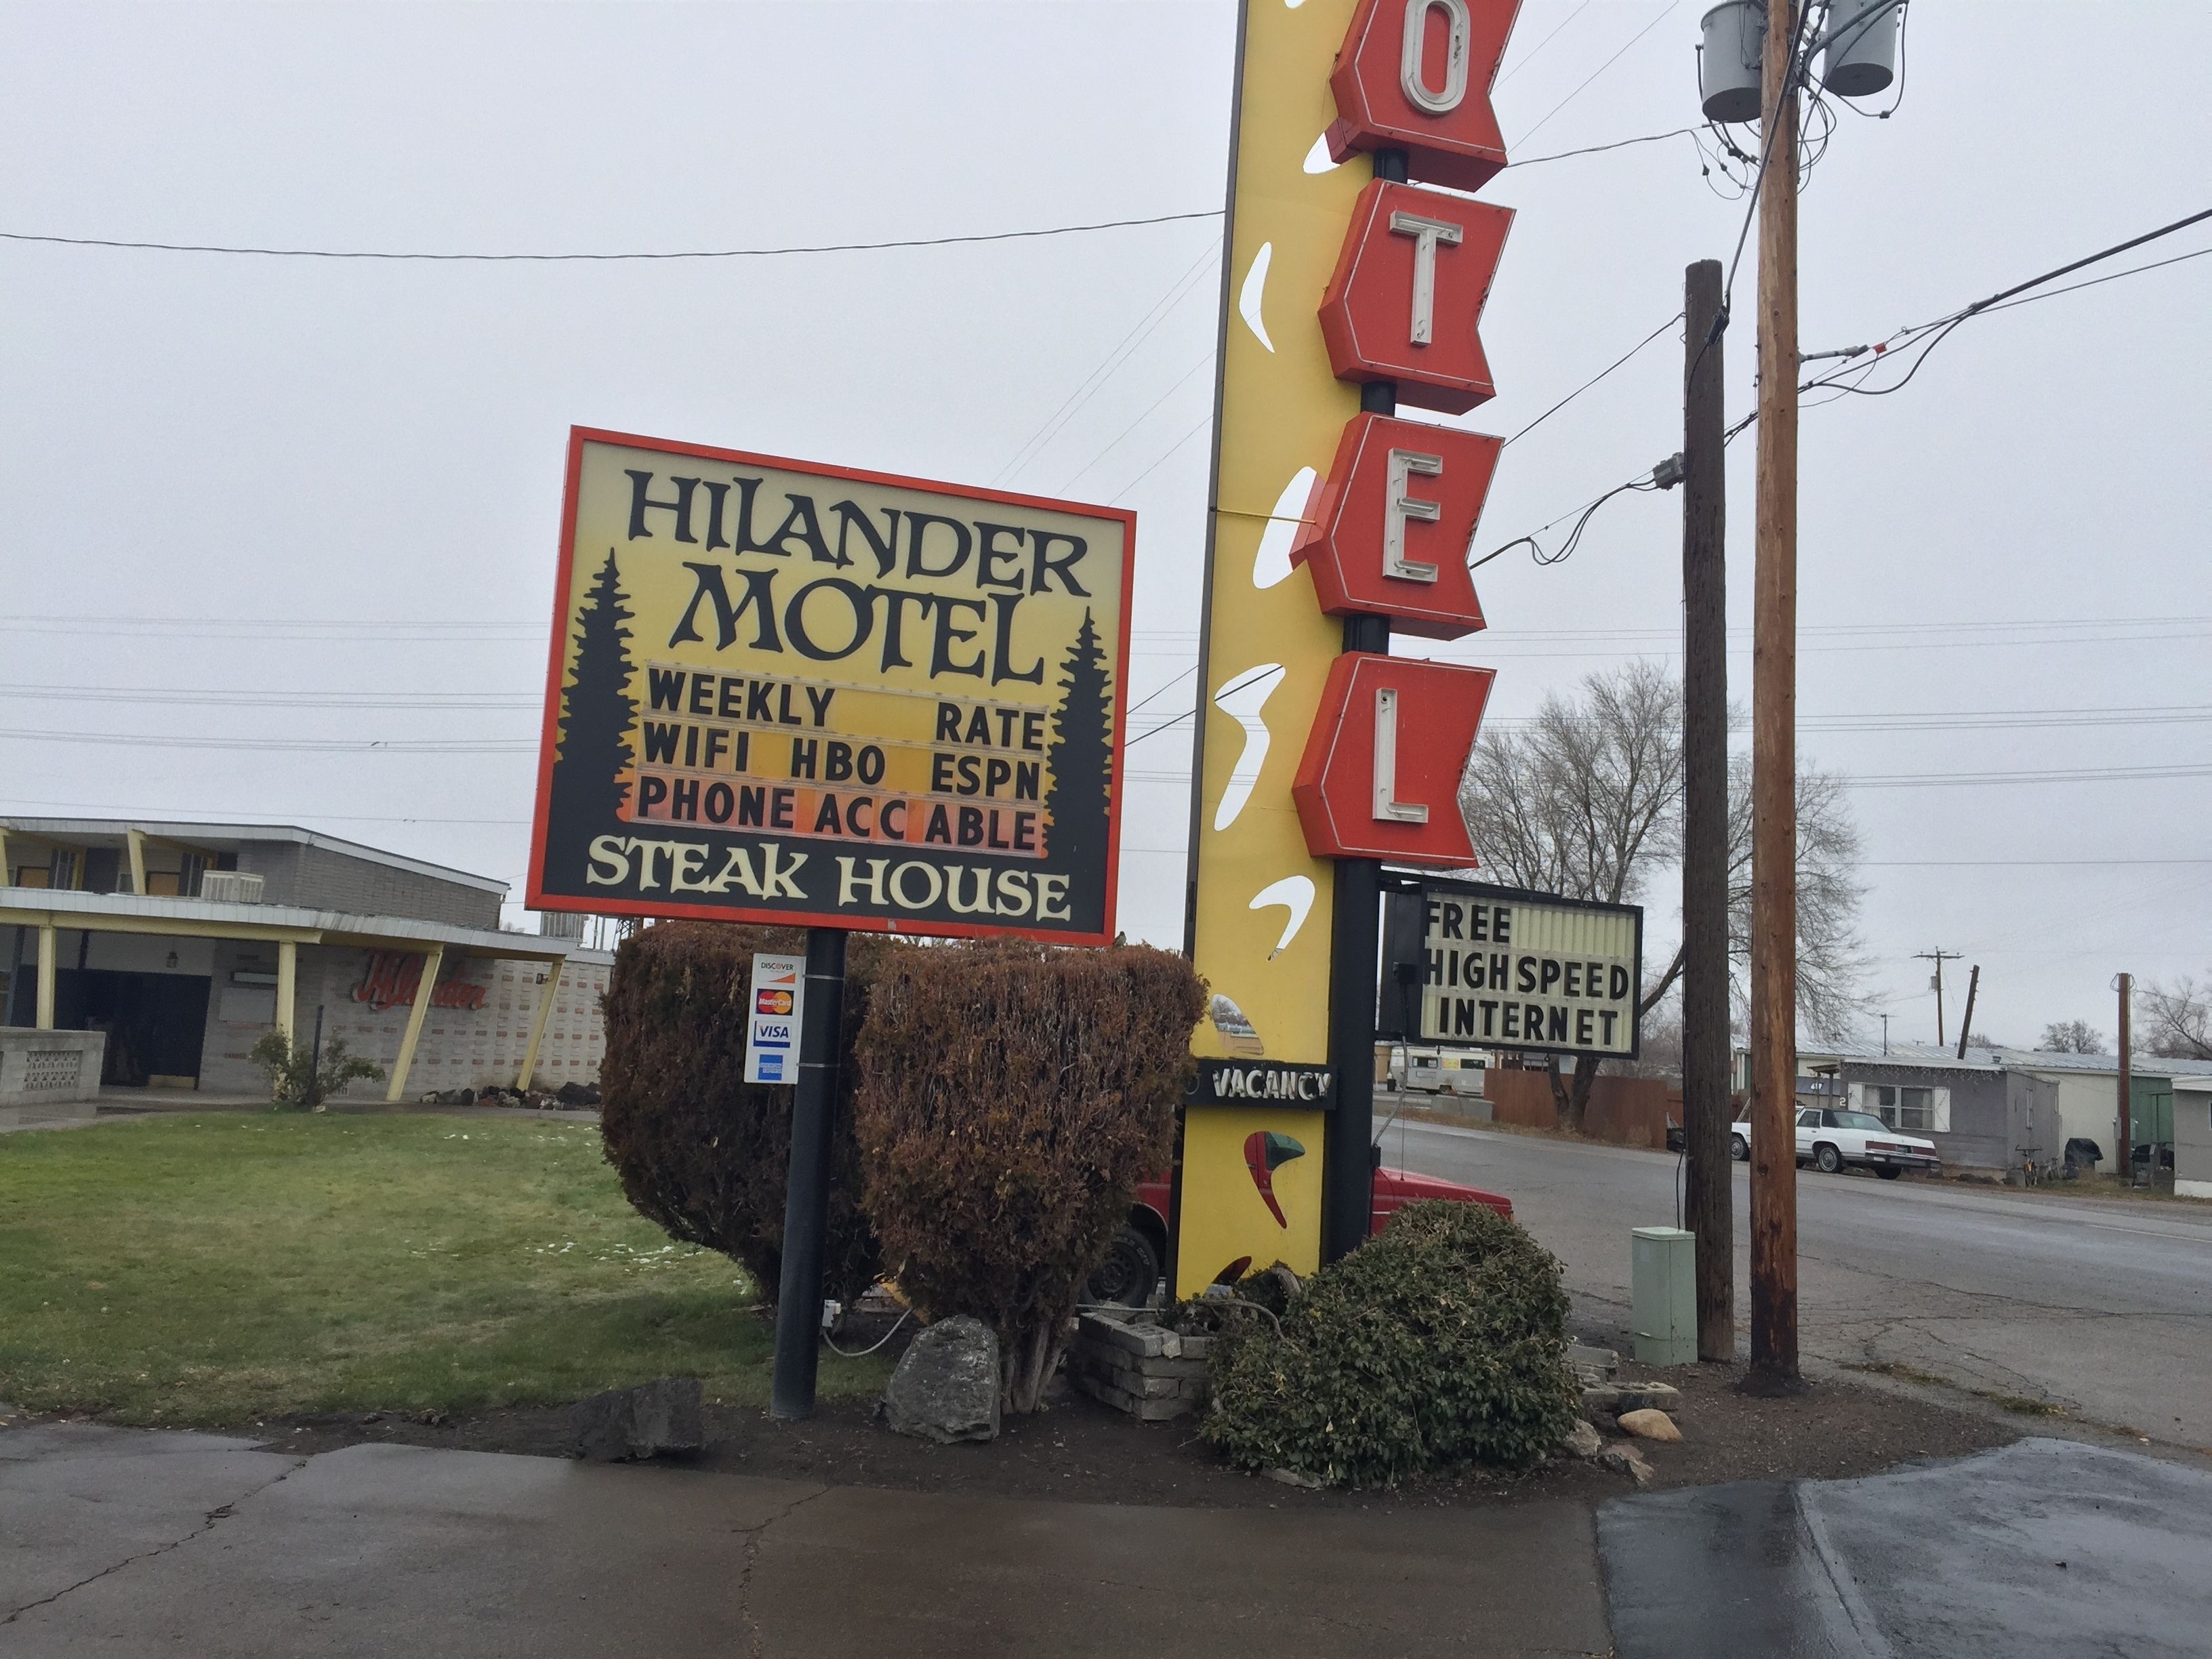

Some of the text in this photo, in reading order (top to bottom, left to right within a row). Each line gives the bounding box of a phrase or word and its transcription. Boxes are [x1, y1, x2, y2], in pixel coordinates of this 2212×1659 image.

[624, 469, 1092, 597] HILANDER
[669, 562, 1045, 686] MOTEL
[647, 668, 1044, 751] WEEKLY RATE
[643, 722, 1040, 800] WIFI HBO ESPN
[638, 777, 794, 829] PHONE
[586, 835, 1071, 921] STEAK HOUSE
[1425, 901, 1511, 943] FREE
[760, 1026, 789, 1038] VISA
[1439, 998, 1618, 1045] INTERNET
[1212, 1068, 1331, 1100] VACANCY
